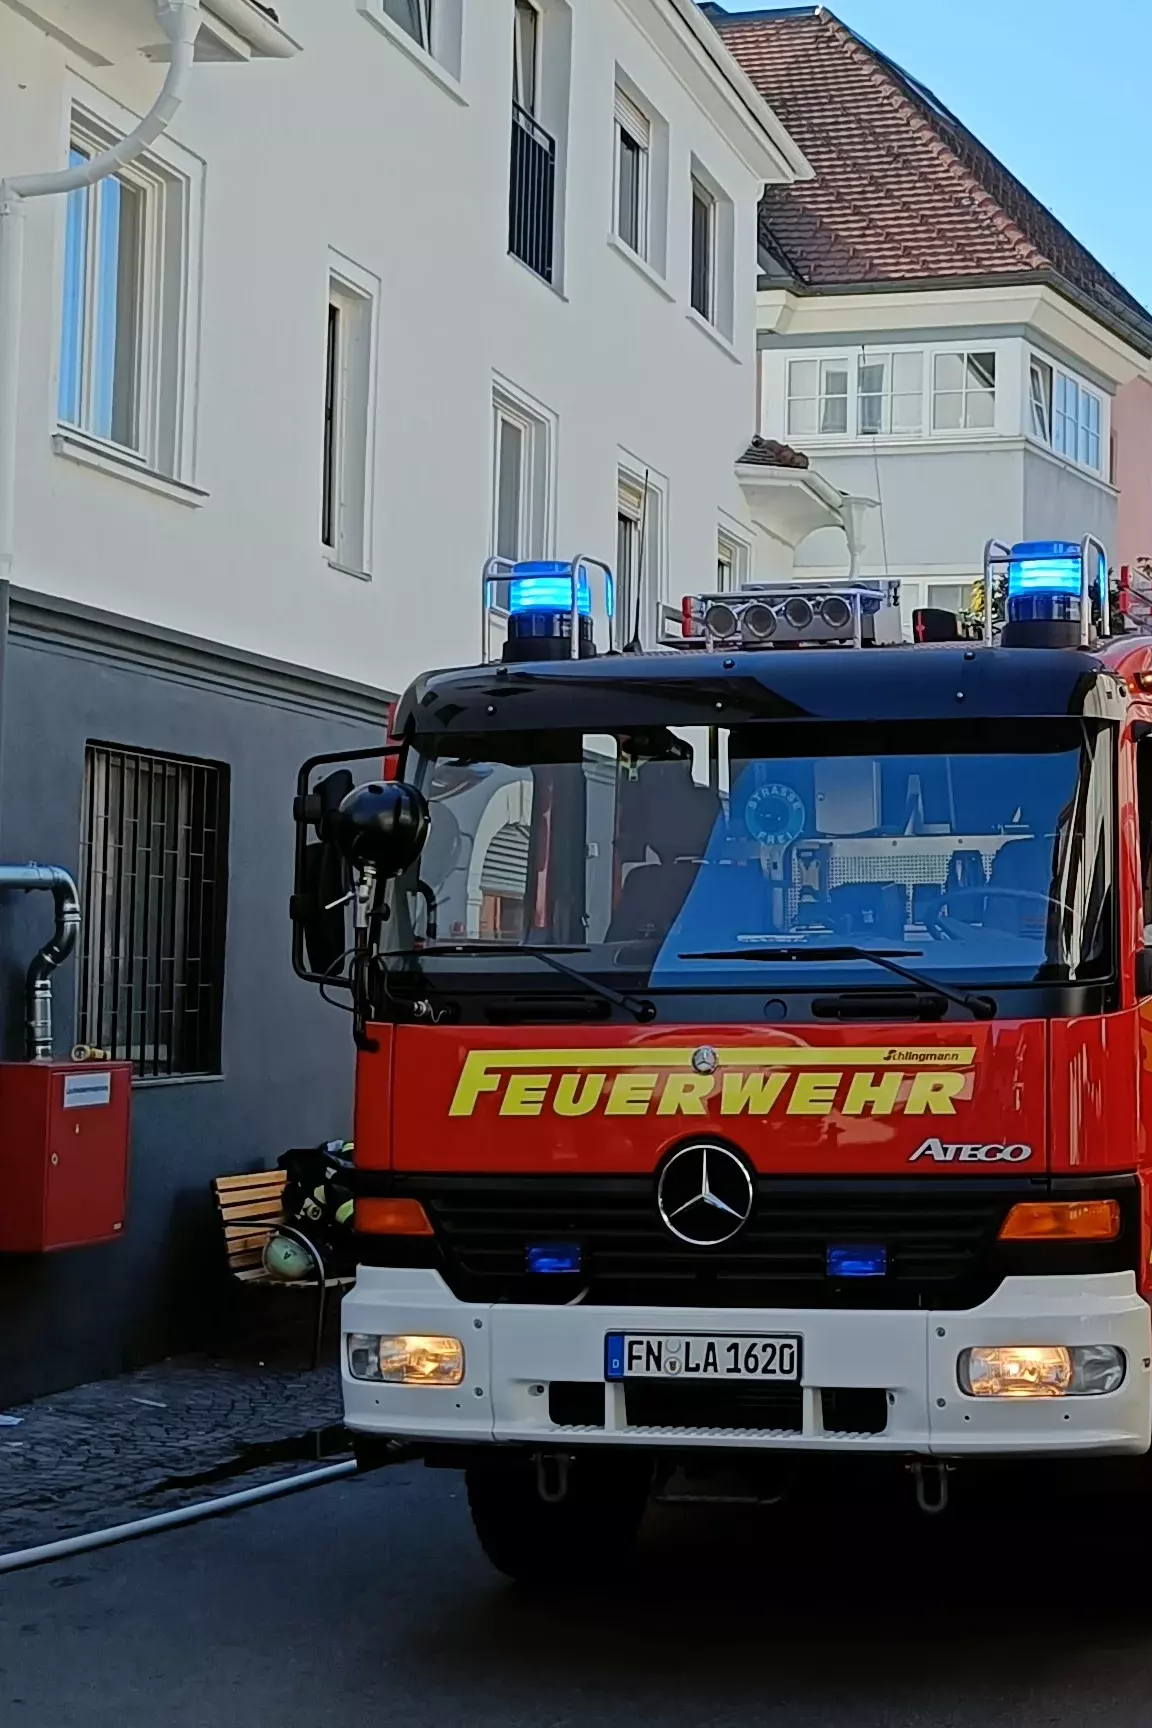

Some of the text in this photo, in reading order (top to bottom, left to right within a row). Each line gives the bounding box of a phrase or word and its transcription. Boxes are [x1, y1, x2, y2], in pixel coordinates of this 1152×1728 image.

[748, 785, 801, 810] STRASSE
[757, 831, 793, 845] FREI
[883, 1050, 959, 1062] Schlingmann
[448, 1047, 976, 1116] FEUERWEHR
[612, 1359, 619, 1369] D
[627, 1340, 795, 1375] FN LA 1620
